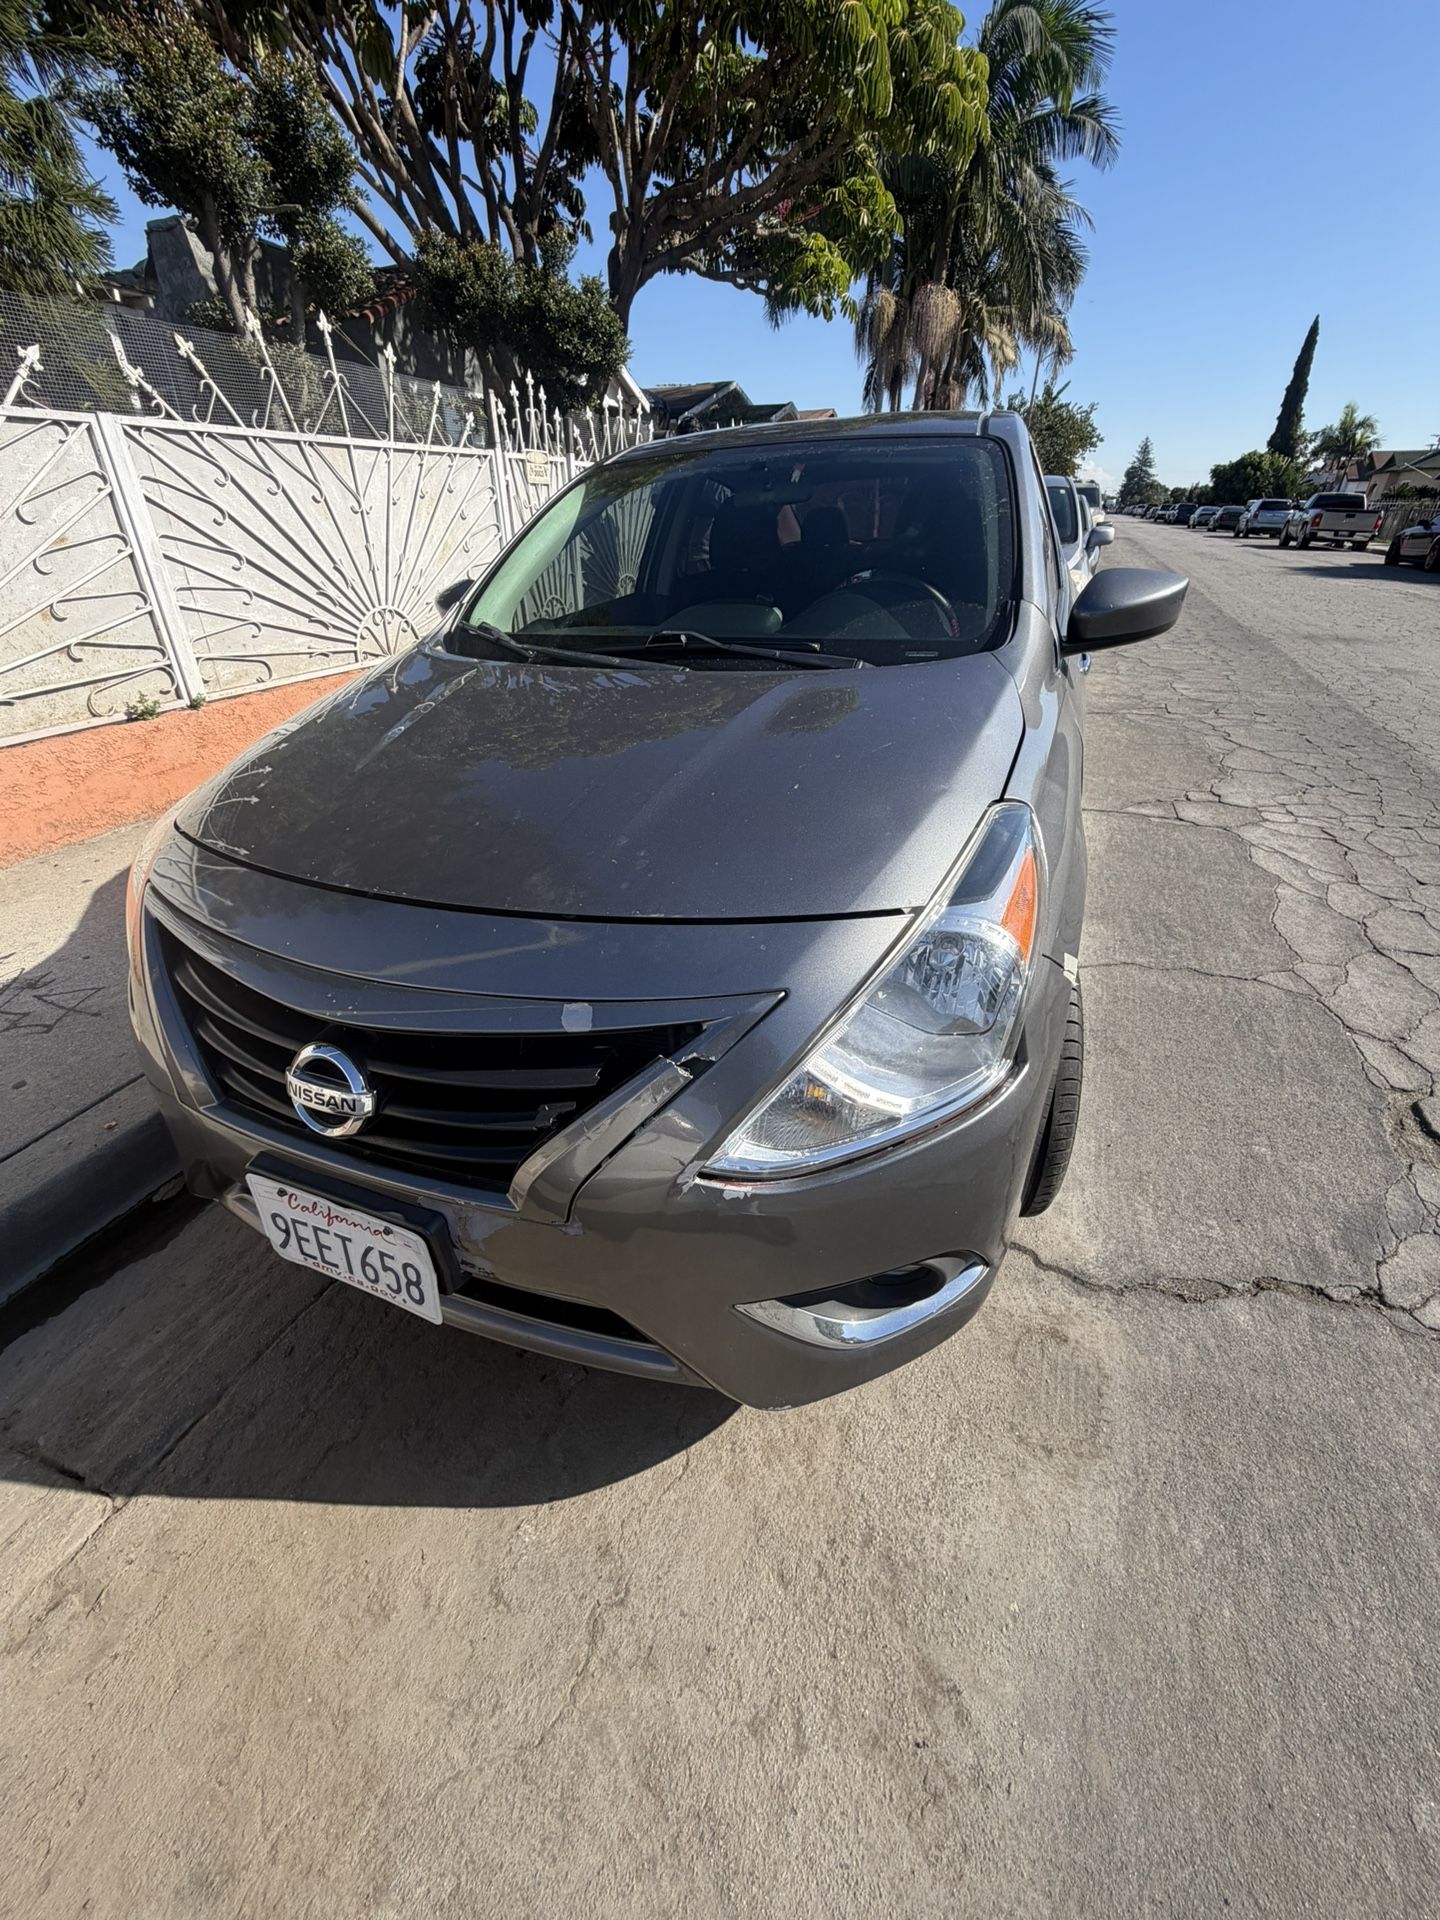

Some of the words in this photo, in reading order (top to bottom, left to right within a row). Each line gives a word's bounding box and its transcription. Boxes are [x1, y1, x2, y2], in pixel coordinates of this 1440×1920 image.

[288, 1081, 356, 1112] NISSAN
[287, 1193, 387, 1240] California
[271, 1212, 425, 1306] 9EET658
